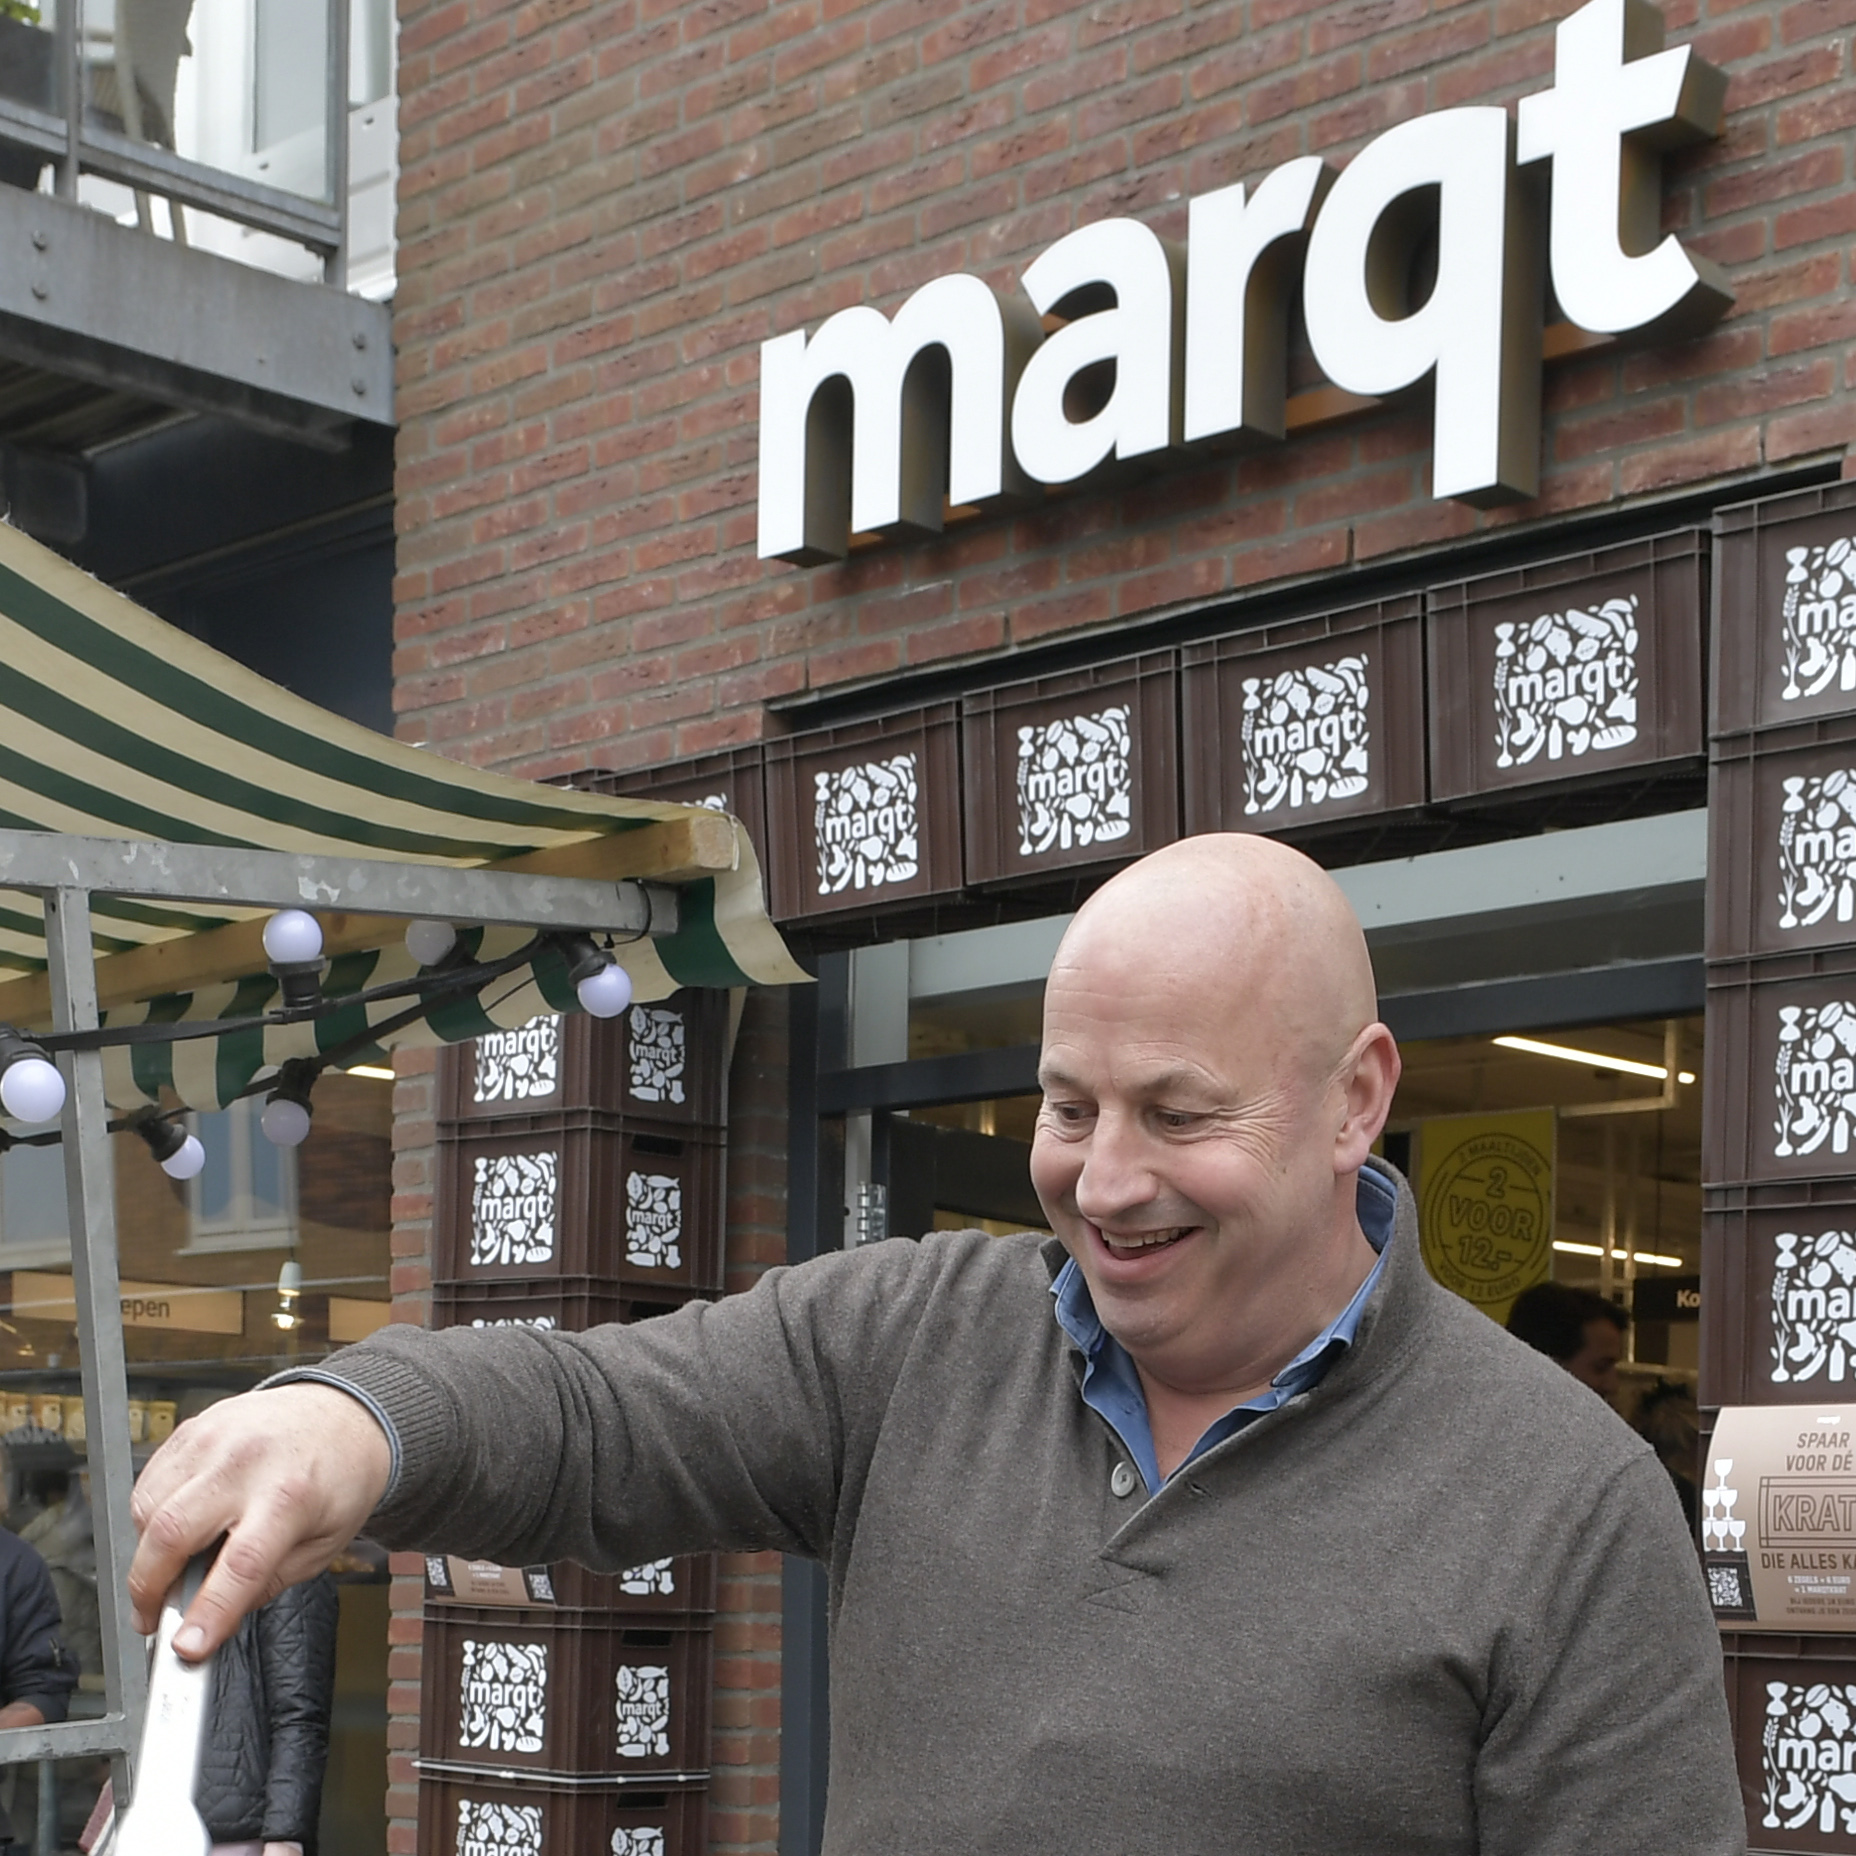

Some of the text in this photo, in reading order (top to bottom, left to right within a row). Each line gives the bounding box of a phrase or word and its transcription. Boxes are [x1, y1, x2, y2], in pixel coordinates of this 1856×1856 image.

[757, 0, 1701, 562] marqt
[1509, 649, 1623, 707] marqt
[1254, 705, 1357, 758] marqt
[1028, 757, 1121, 802] marqt
[825, 799, 909, 849] marqt
[484, 1026, 549, 1062] marqt
[635, 1043, 676, 1065] marqt
[1486, 1166, 1508, 1198] 2
[481, 1195, 547, 1229] marqt
[632, 1209, 672, 1229] marqt
[1449, 1194, 1534, 1242] VOOR
[1797, 1432, 1850, 1449] SPAAR
[1786, 1455, 1826, 1472] VOOR
[1761, 1553, 1785, 1569] DIE
[1790, 1553, 1838, 1570] ALLES
[470, 1679, 539, 1719] marqt
[622, 1699, 663, 1720] marqt
